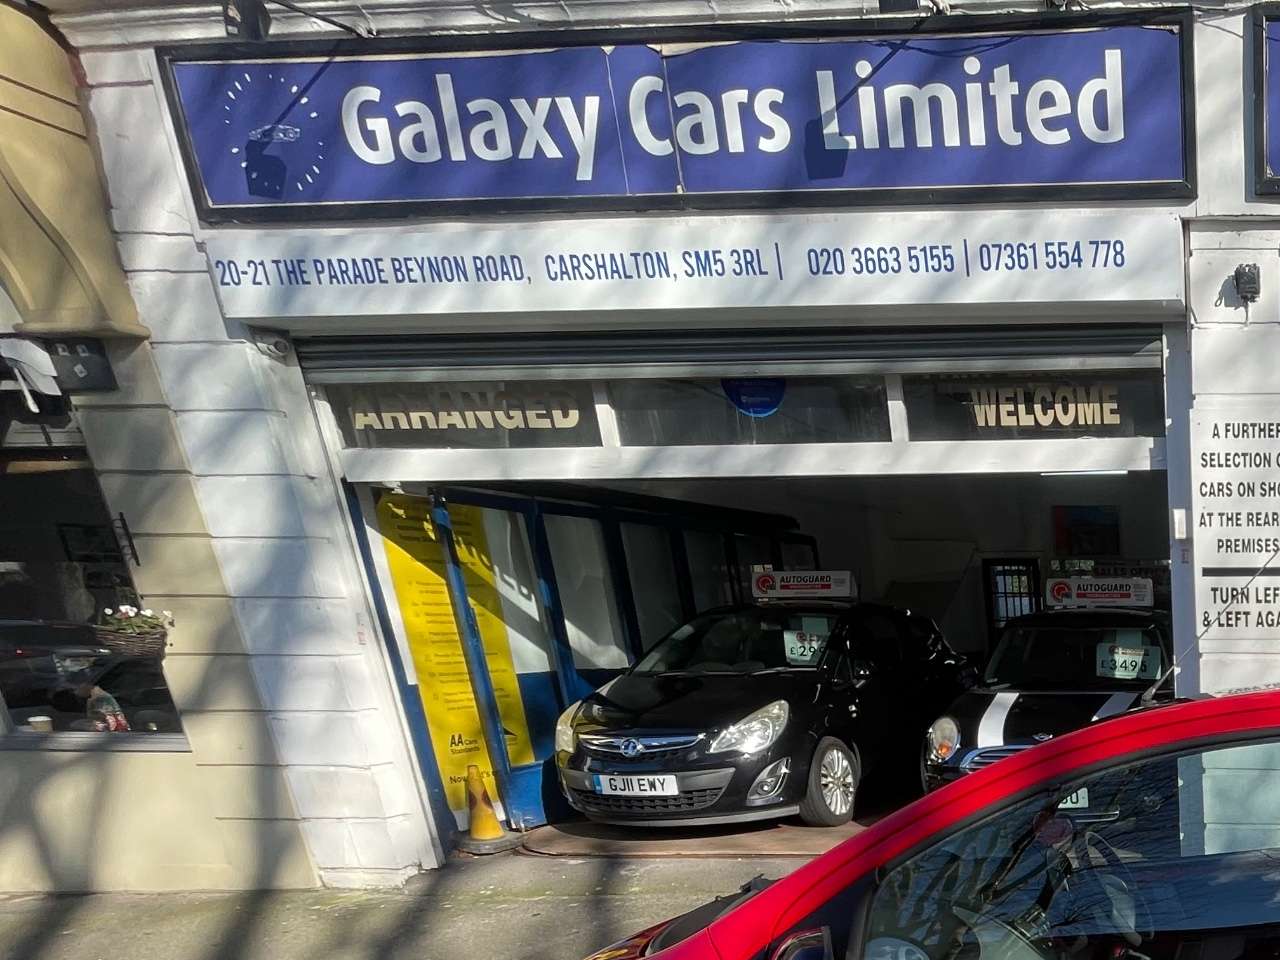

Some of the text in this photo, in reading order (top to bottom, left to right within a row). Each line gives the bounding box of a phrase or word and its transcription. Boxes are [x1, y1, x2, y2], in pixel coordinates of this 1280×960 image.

[341, 49, 1126, 181] Galaxy Cars Limited
[215, 239, 1126, 287] 20-21 THE PARADE BEYNON ROAD, CARSHALTON, SM5 3RL 020 3663 5155 07361 554 778
[353, 391, 580, 430] ARRANGED
[970, 384, 1121, 427] WELCOME
[1212, 422, 1221, 439] A
[1200, 452, 1272, 468] SELECTION
[1199, 482, 1233, 497] CARS
[1237, 482, 1255, 497] ON
[1199, 512, 1214, 527] AT
[1217, 512, 1243, 527] THE
[1246, 511, 1280, 527] REAR
[1216, 538, 1280, 554] PREMISES
[779, 574, 832, 584] AUTOGUARD
[1076, 583, 1131, 592] AUTOGUARD
[1210, 586, 1250, 604] TURN
[1202, 611, 1212, 627] &
[1217, 611, 1251, 627] LEFT
[449, 733, 464, 747] AA
[608, 777, 666, 792] GJ11 EWY
